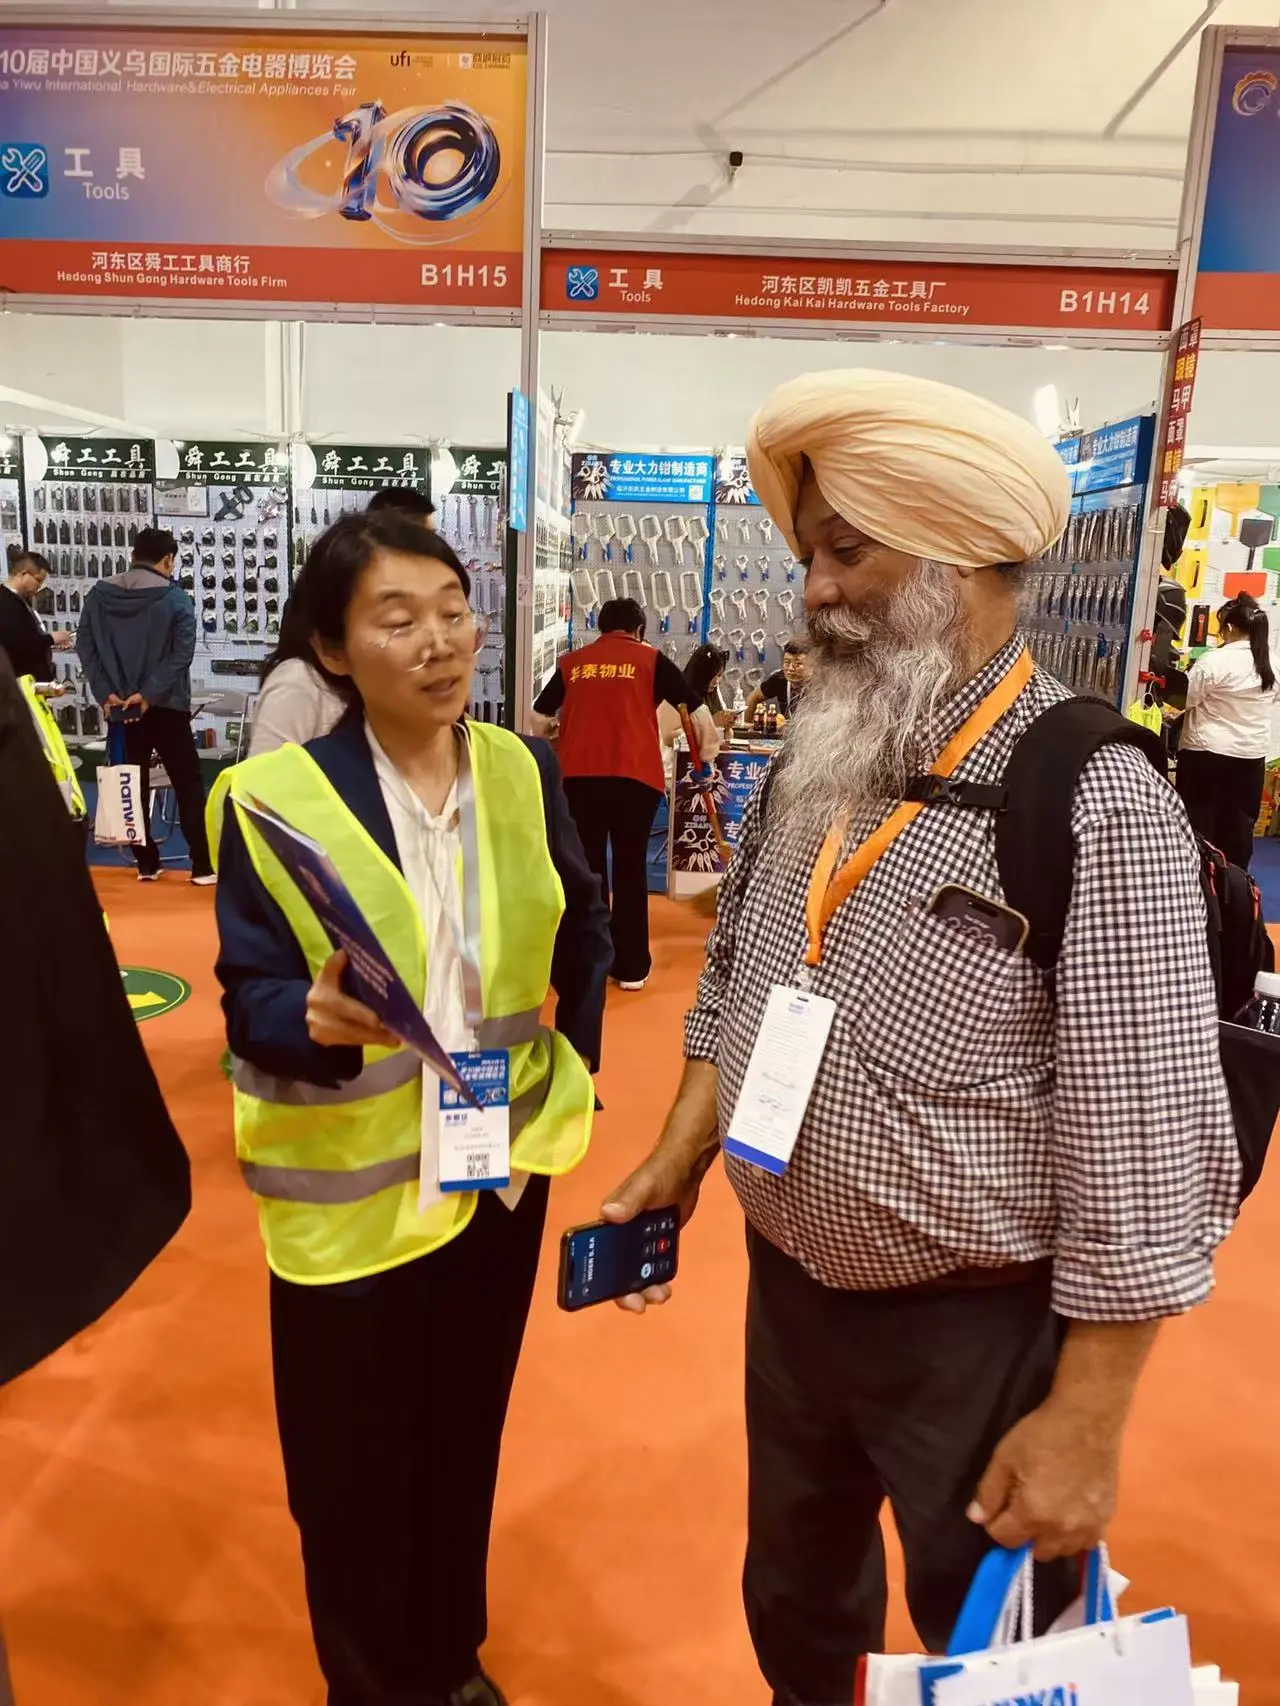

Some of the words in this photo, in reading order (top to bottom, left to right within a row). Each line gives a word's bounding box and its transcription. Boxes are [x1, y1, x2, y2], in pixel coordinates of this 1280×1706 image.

[0, 49, 357, 80] 10届中国义乌国际五金电器博览会
[13, 78, 42, 90] Yiwu
[45, 79, 122, 92] International
[259, 83, 329, 97] Appliances
[333, 84, 357, 97] Fair
[82, 182, 129, 200] Tools
[92, 251, 250, 274] 河东区舜工工具商行
[57, 271, 102, 284] Hedong
[104, 272, 134, 283] Shun
[136, 273, 167, 287] Gong
[170, 274, 225, 286] Hardware
[227, 275, 258, 287] Tools
[261, 276, 287, 288] Firm
[421, 263, 507, 287] B1H15
[620, 290, 652, 303] Tools
[762, 275, 946, 300] 河东区凯凯五金工具厂
[735, 295, 781, 309] Hedong
[784, 296, 803, 307] Kai
[806, 297, 825, 308] Kai
[828, 298, 885, 311] Hardware
[888, 300, 921, 312] Tools
[923, 301, 970, 316] Factory
[1059, 289, 1150, 315] B1H14
[321, 449, 419, 479] 舜工工具
[610, 459, 708, 477] 专业大力钳制造商
[185, 472, 207, 480] Shun
[213, 473, 236, 482] Gong
[322, 477, 345, 485] Shun
[351, 477, 374, 487] Gong
